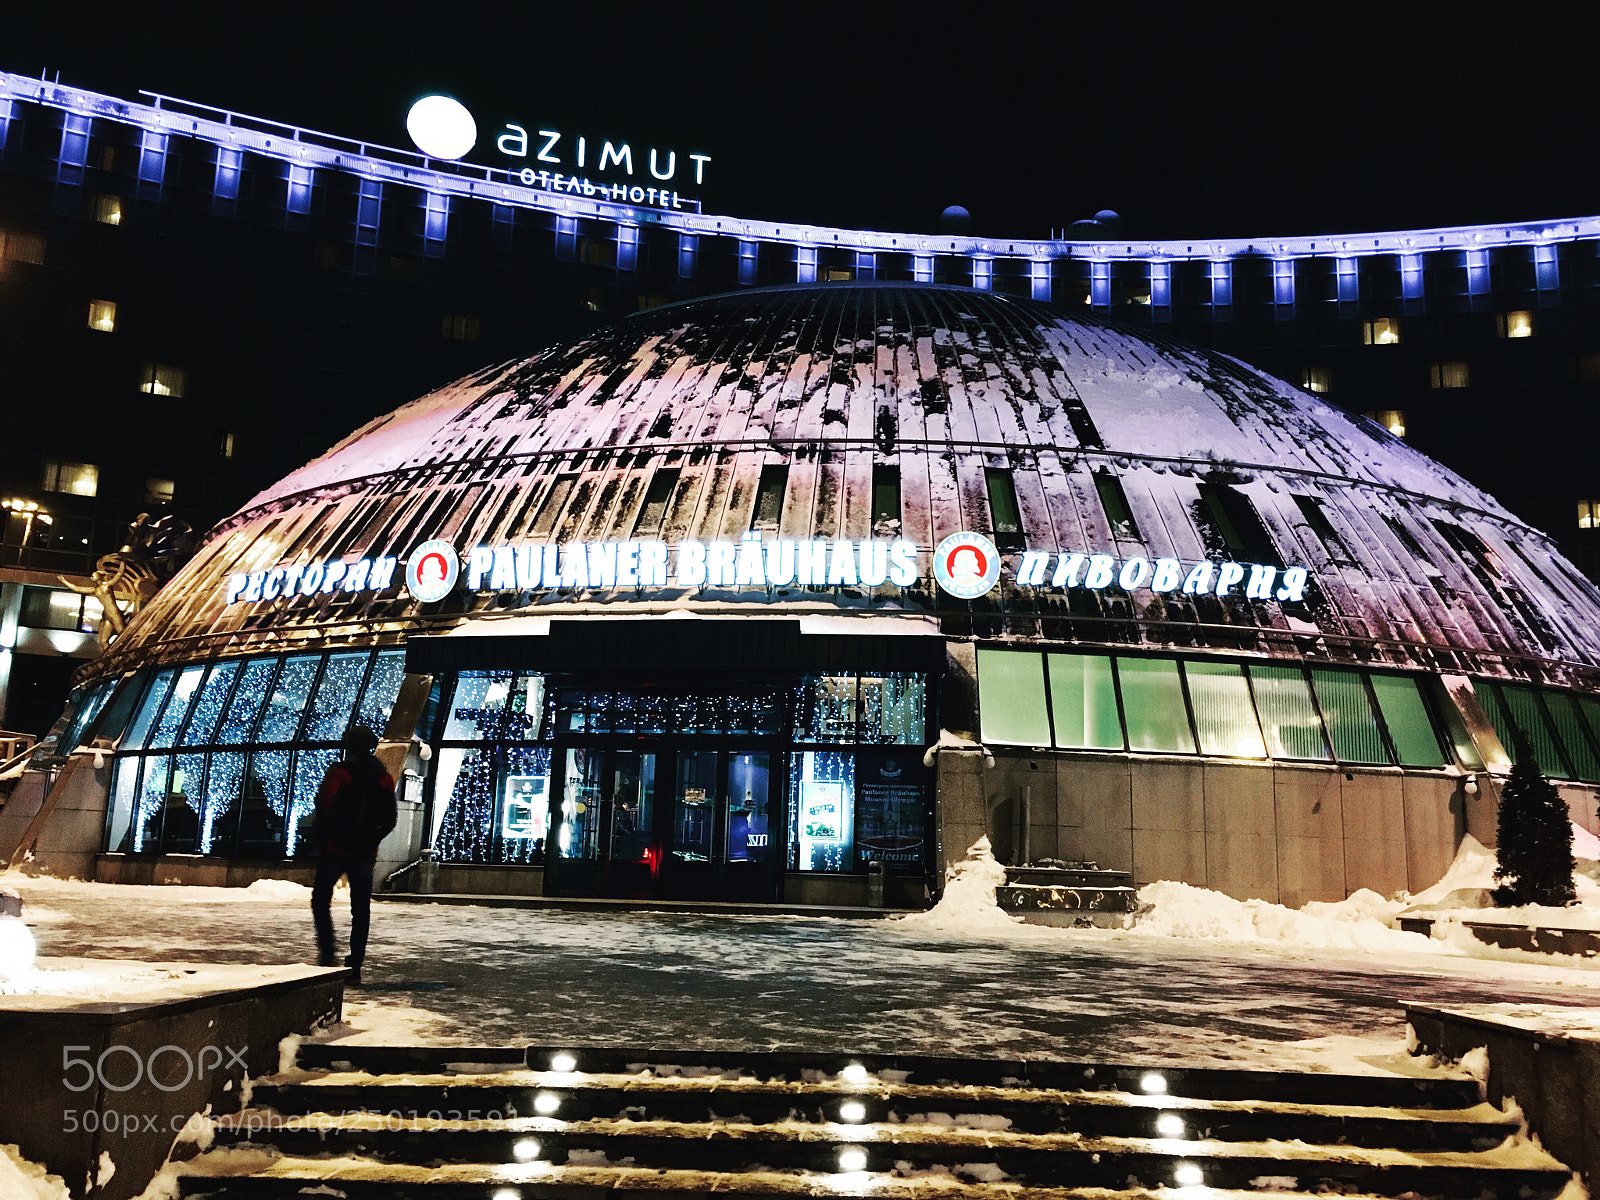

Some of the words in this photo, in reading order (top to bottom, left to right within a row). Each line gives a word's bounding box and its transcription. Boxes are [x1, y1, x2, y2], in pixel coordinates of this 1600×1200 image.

[520, 168, 596, 196] ОТЕЛЬ
[612, 183, 682, 209] HOTEL
[226, 557, 397, 605] РЕСТОРАН
[467, 540, 669, 590] PAULANER
[677, 531, 917, 587] BRÄUHAUS
[1016, 551, 1308, 602] ПИВОВАРНЯ
[860, 849, 920, 862] Welcome
